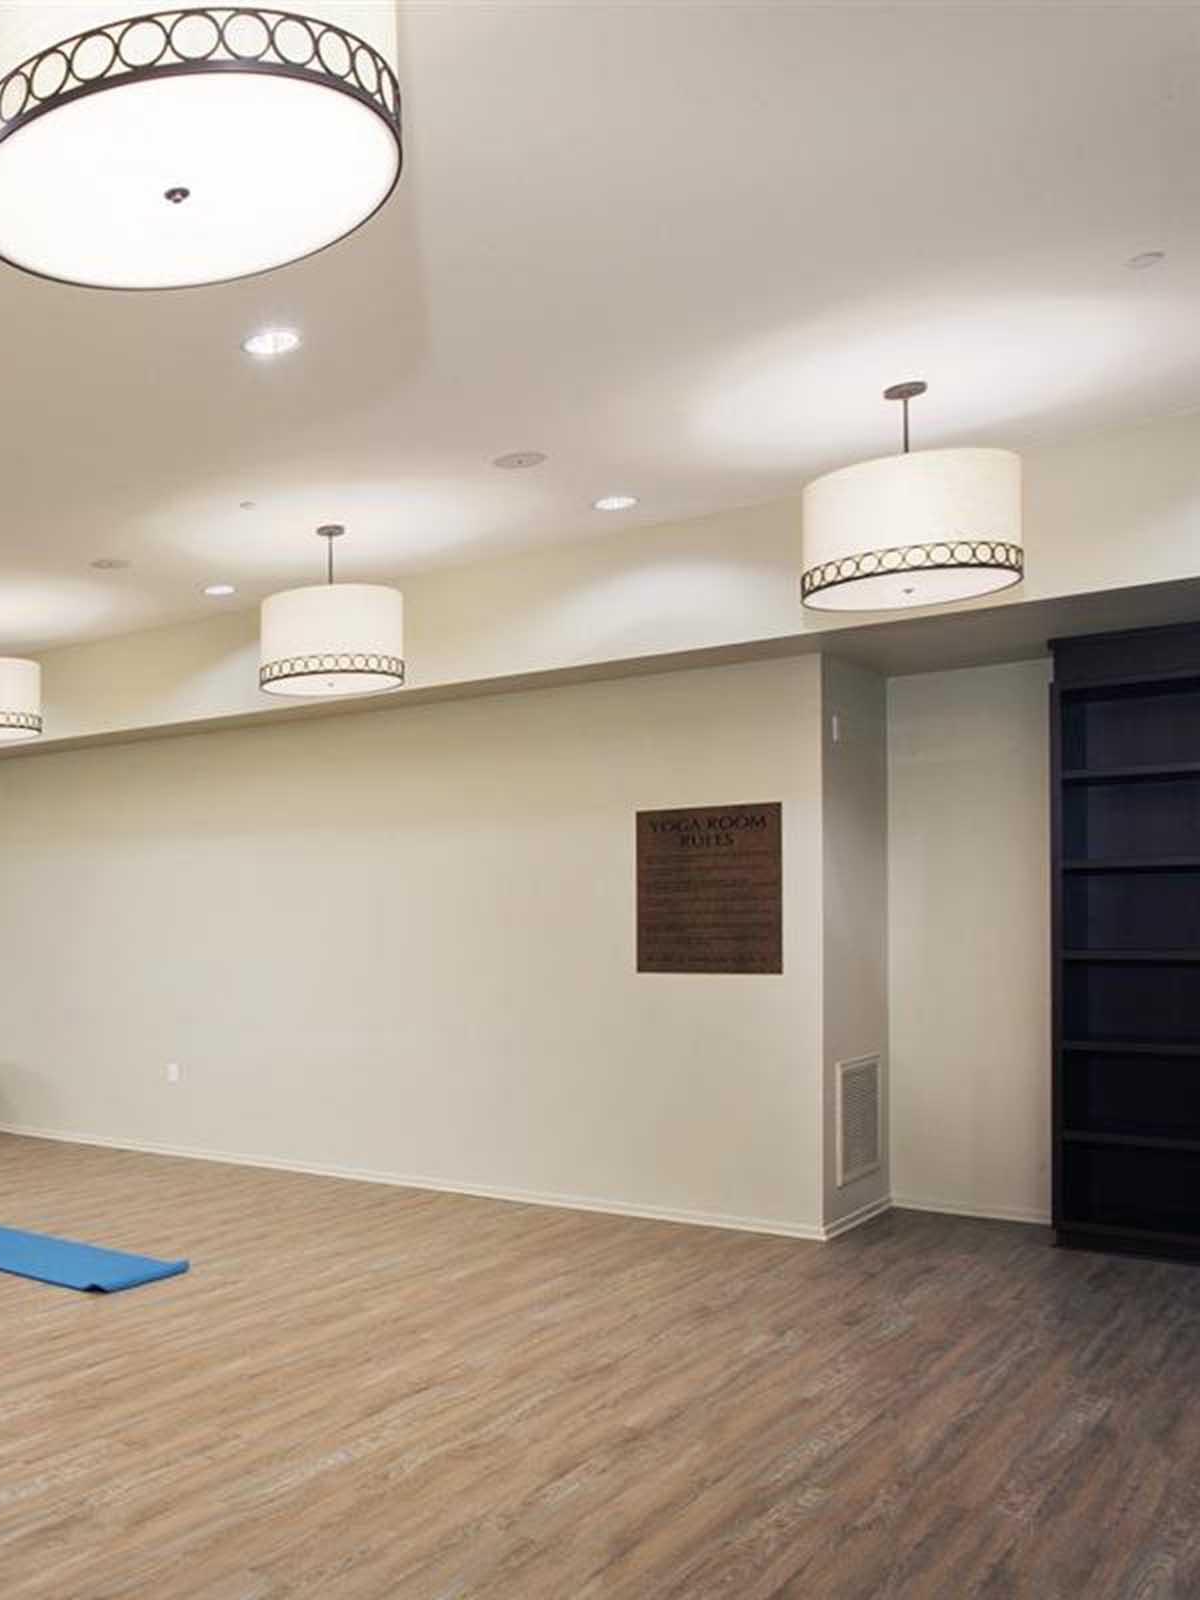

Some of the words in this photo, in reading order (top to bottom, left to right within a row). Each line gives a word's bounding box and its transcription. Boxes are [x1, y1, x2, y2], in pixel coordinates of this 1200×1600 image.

[648, 818, 702, 833] YOGA
[706, 815, 767, 831] ROOM
[680, 833, 735, 848] RULES
